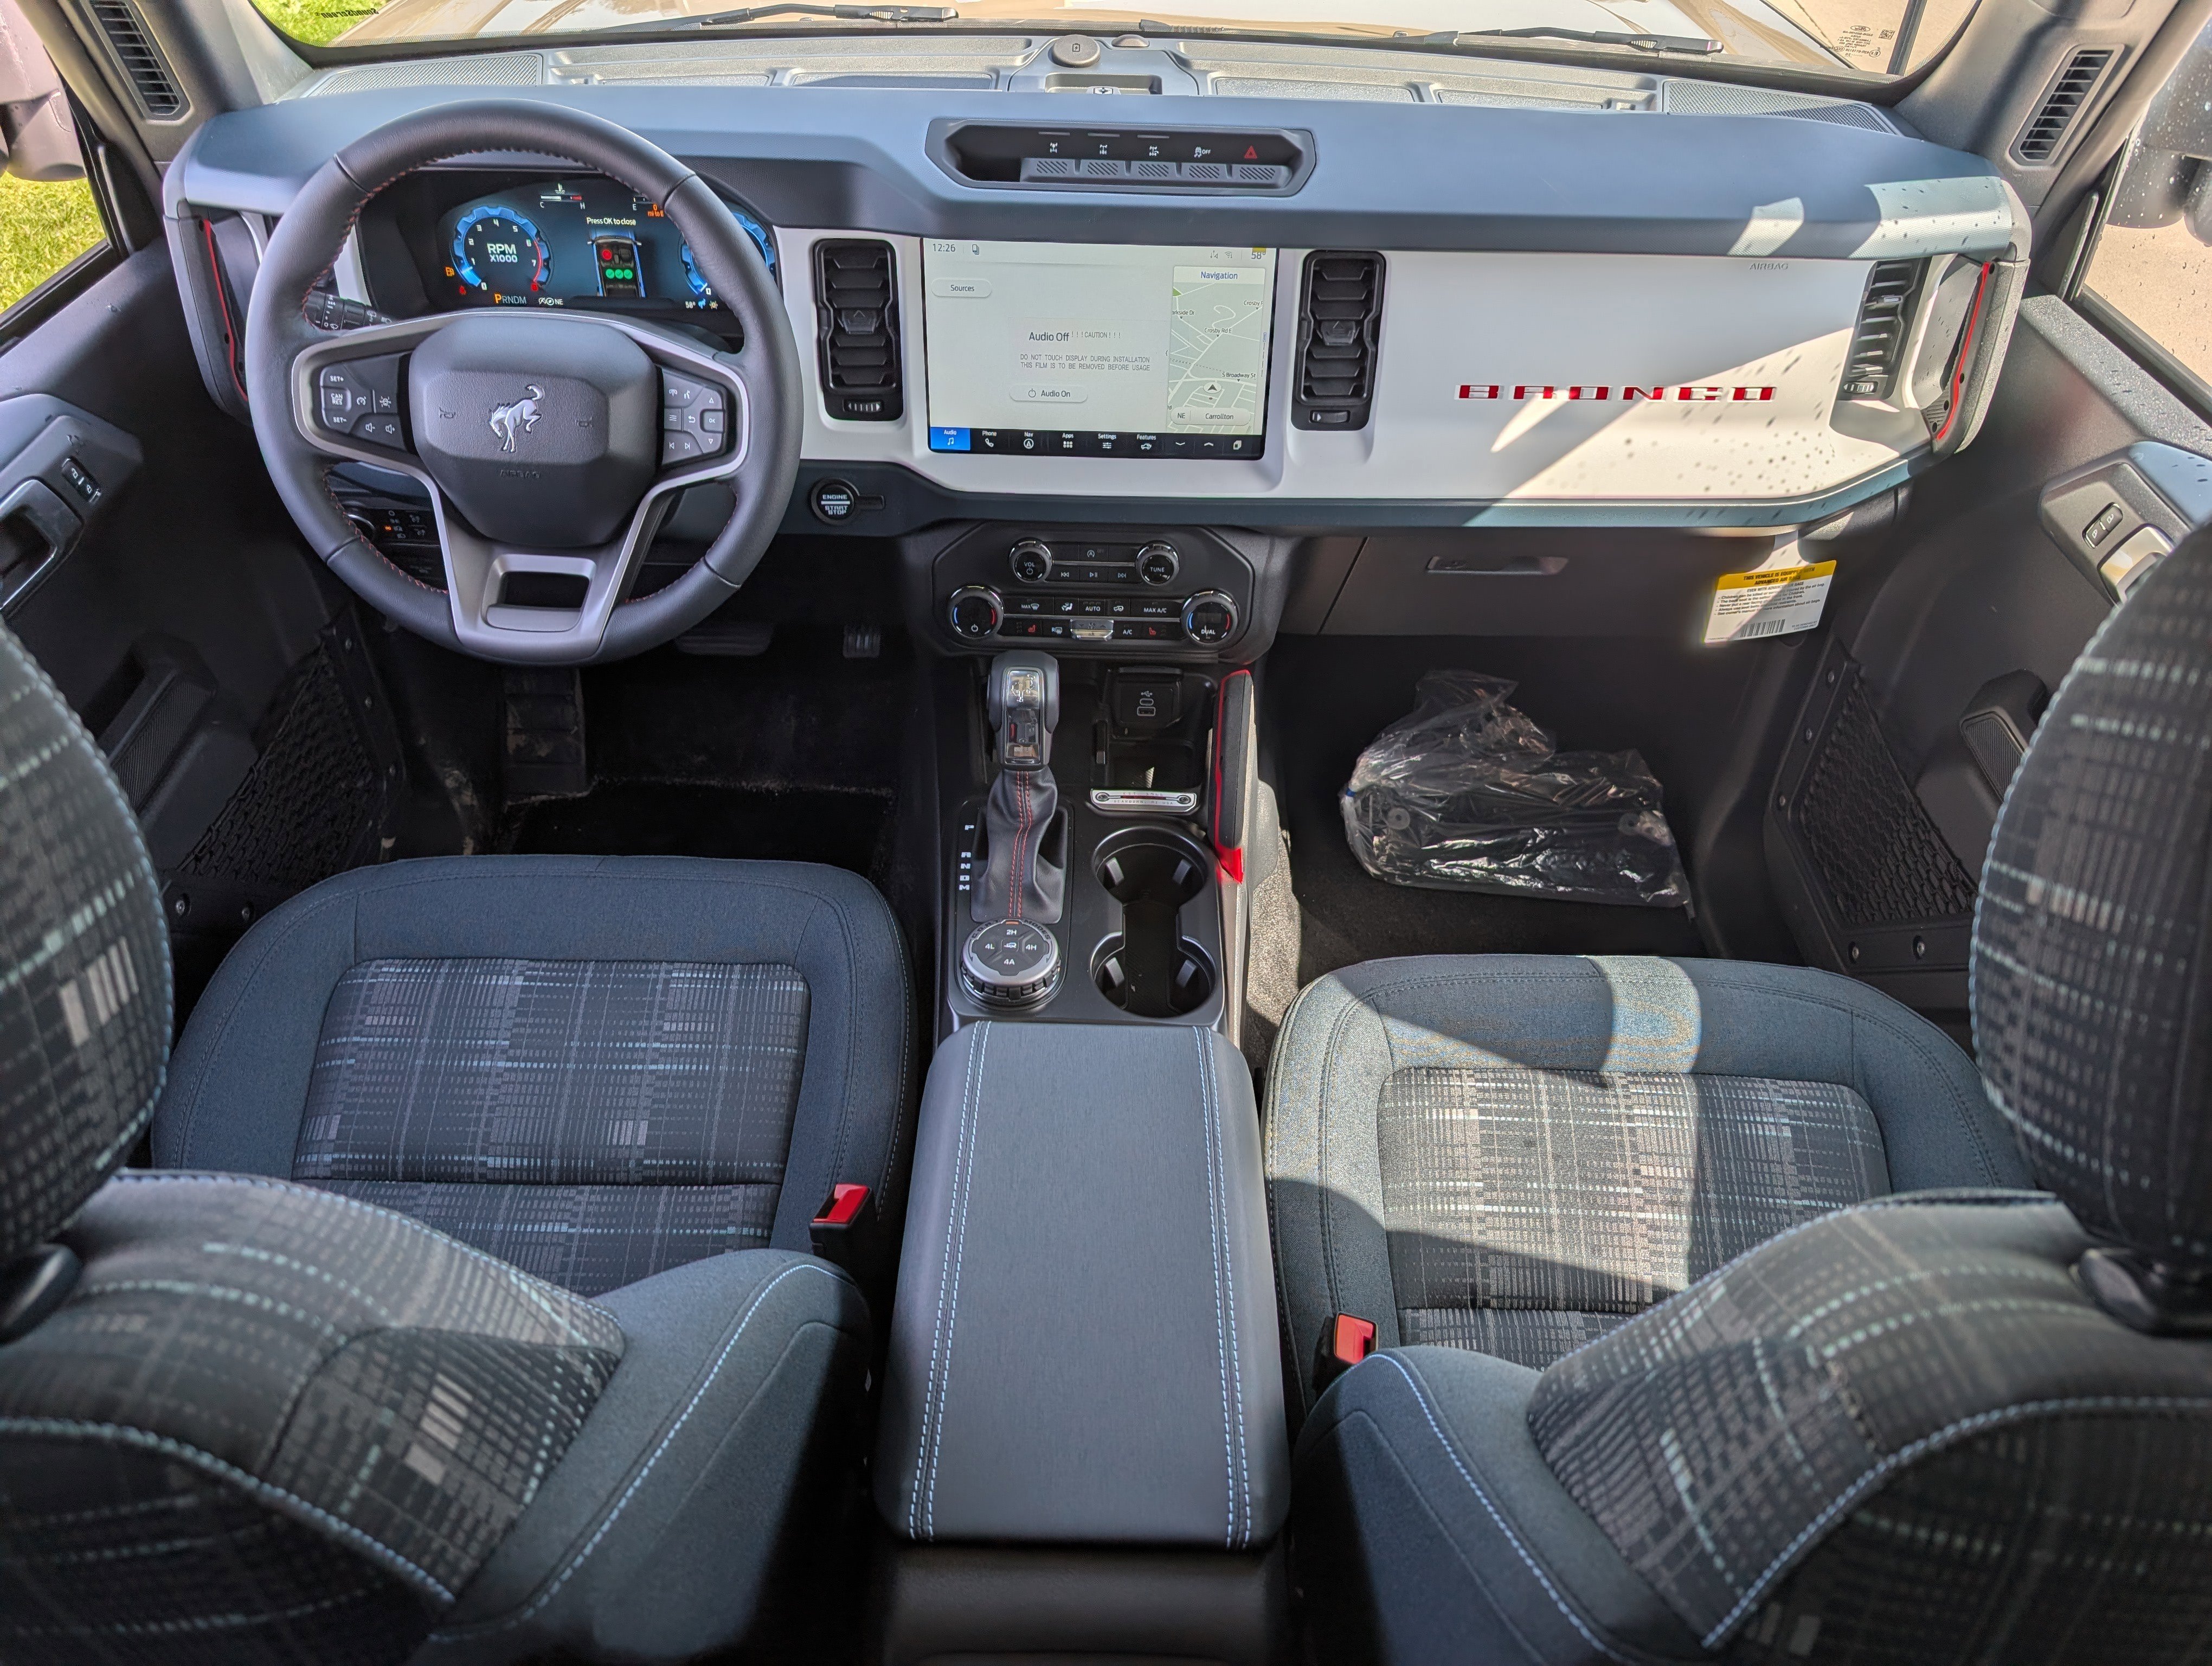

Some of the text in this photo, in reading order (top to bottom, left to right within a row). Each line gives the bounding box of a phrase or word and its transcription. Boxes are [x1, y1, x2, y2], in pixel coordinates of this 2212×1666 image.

[493, 219, 499, 227] 4
[487, 243, 517, 254] RPM
[933, 244, 956, 252] 12:26
[490, 254, 518, 263] X1000
[1200, 271, 1238, 280] Navigation
[481, 282, 487, 291] 0
[1029, 331, 1070, 341] Audio Off
[1454, 384, 1777, 403] BRONCO
[1024, 919, 1051, 940] MODES
